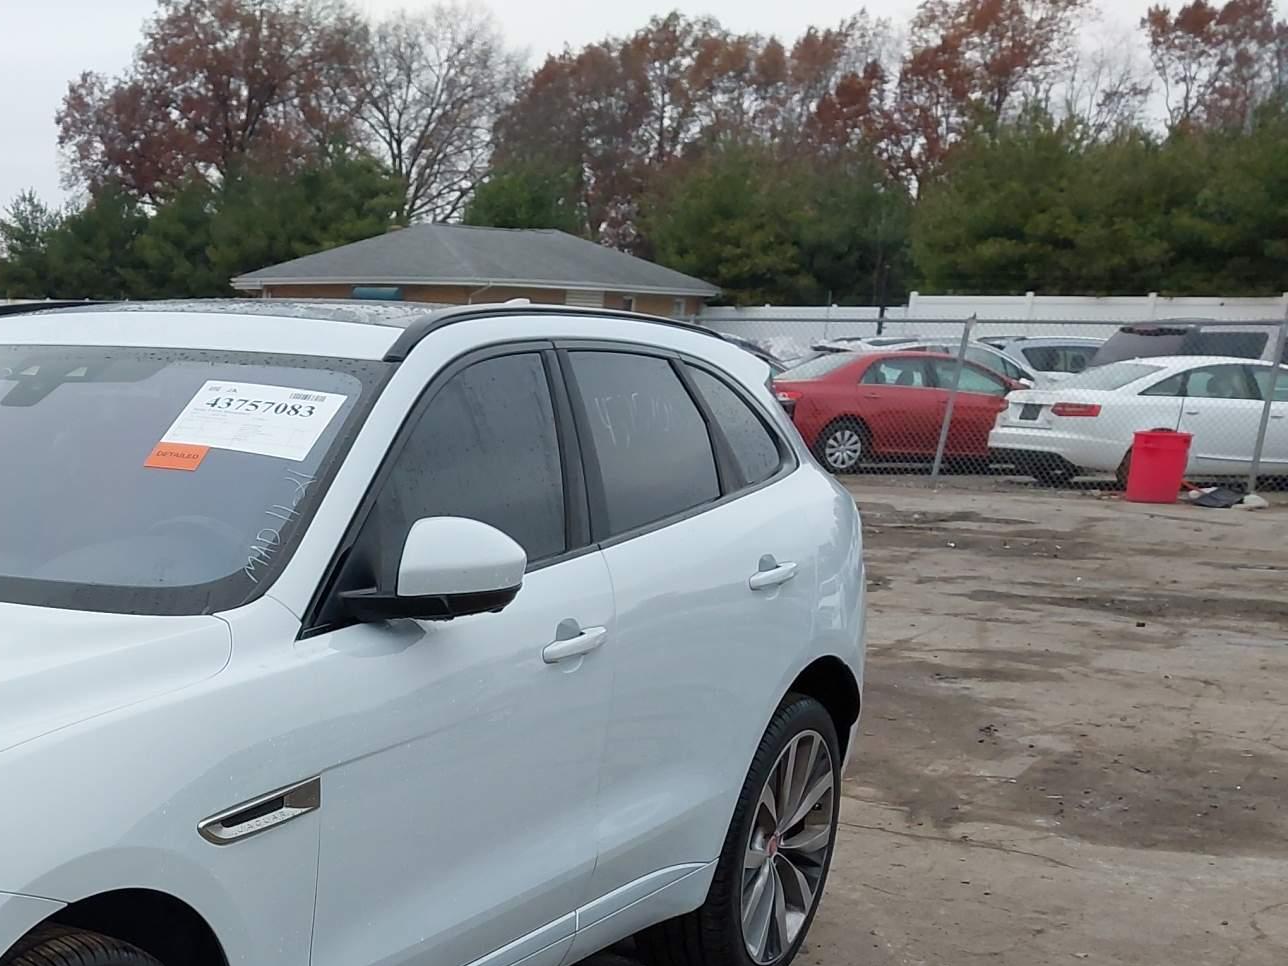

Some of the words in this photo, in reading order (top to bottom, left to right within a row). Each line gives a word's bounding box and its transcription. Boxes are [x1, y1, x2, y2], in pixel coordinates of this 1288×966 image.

[206, 396, 316, 418] 43757083
[156, 449, 200, 460] DETAILED
[244, 528, 281, 583] MAD
